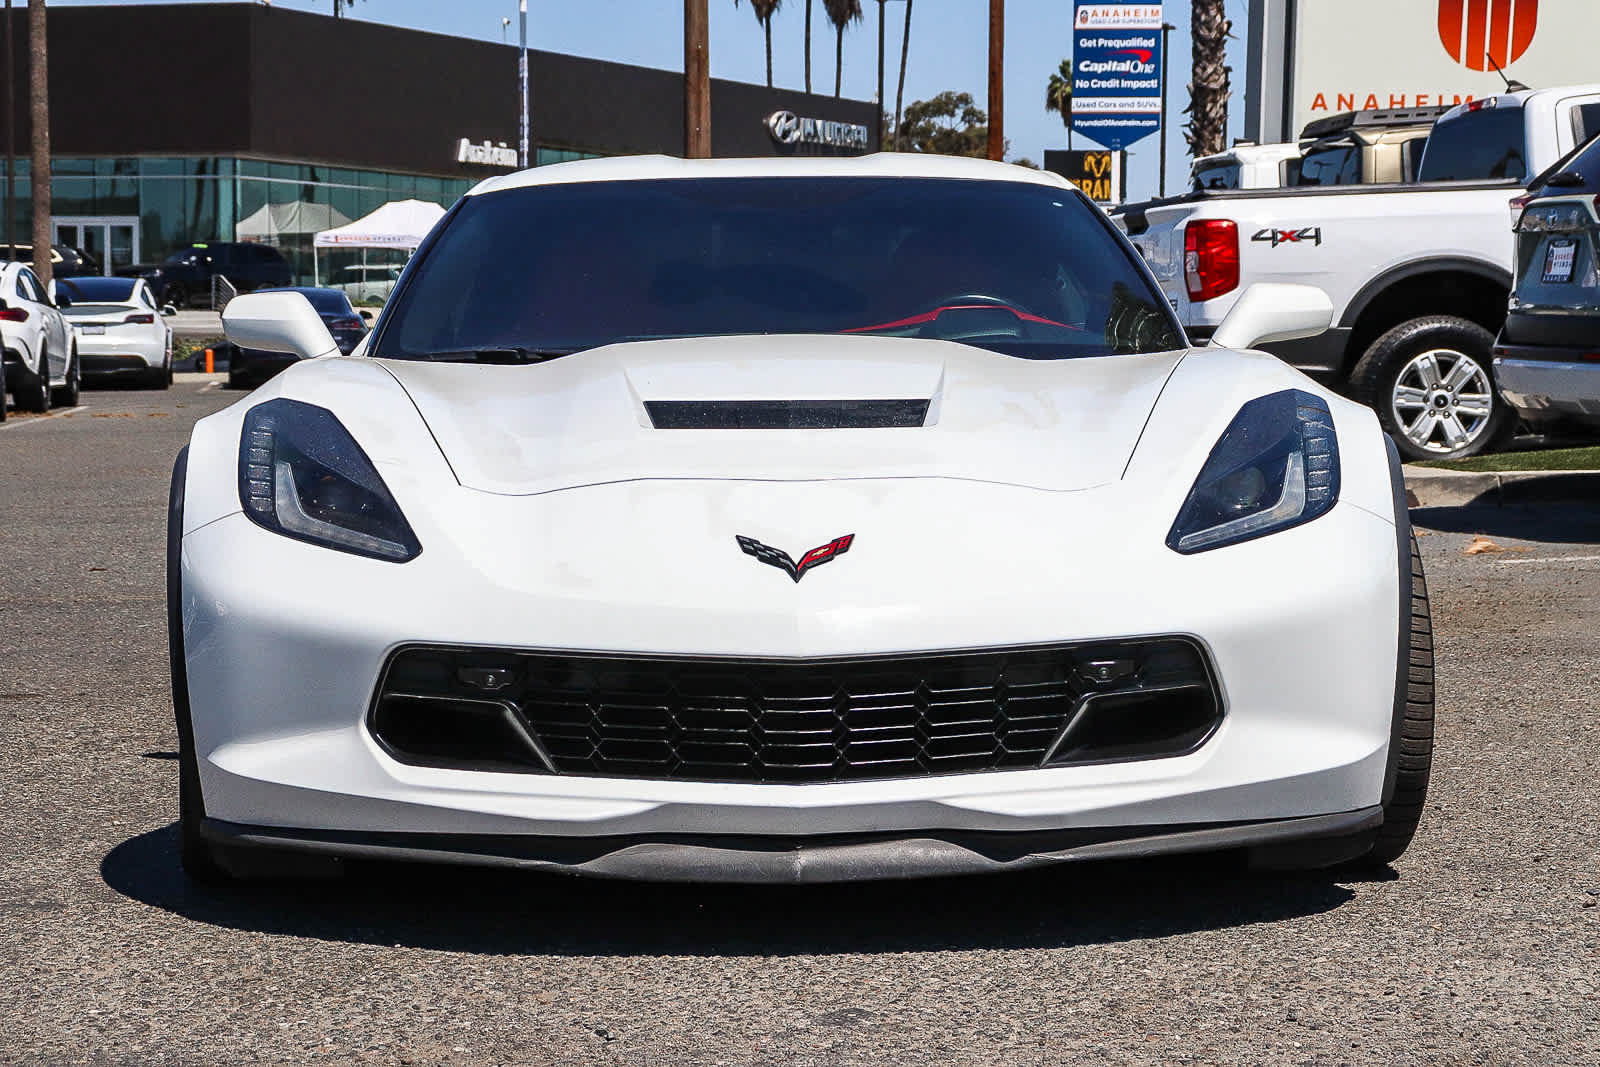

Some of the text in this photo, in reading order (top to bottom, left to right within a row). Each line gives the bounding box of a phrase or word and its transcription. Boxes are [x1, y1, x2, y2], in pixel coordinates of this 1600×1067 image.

[1091, 8, 1160, 17] ANAHEIM
[1080, 37, 1155, 49] Get Prequalified
[1076, 79, 1158, 90] No Credit Impact!
